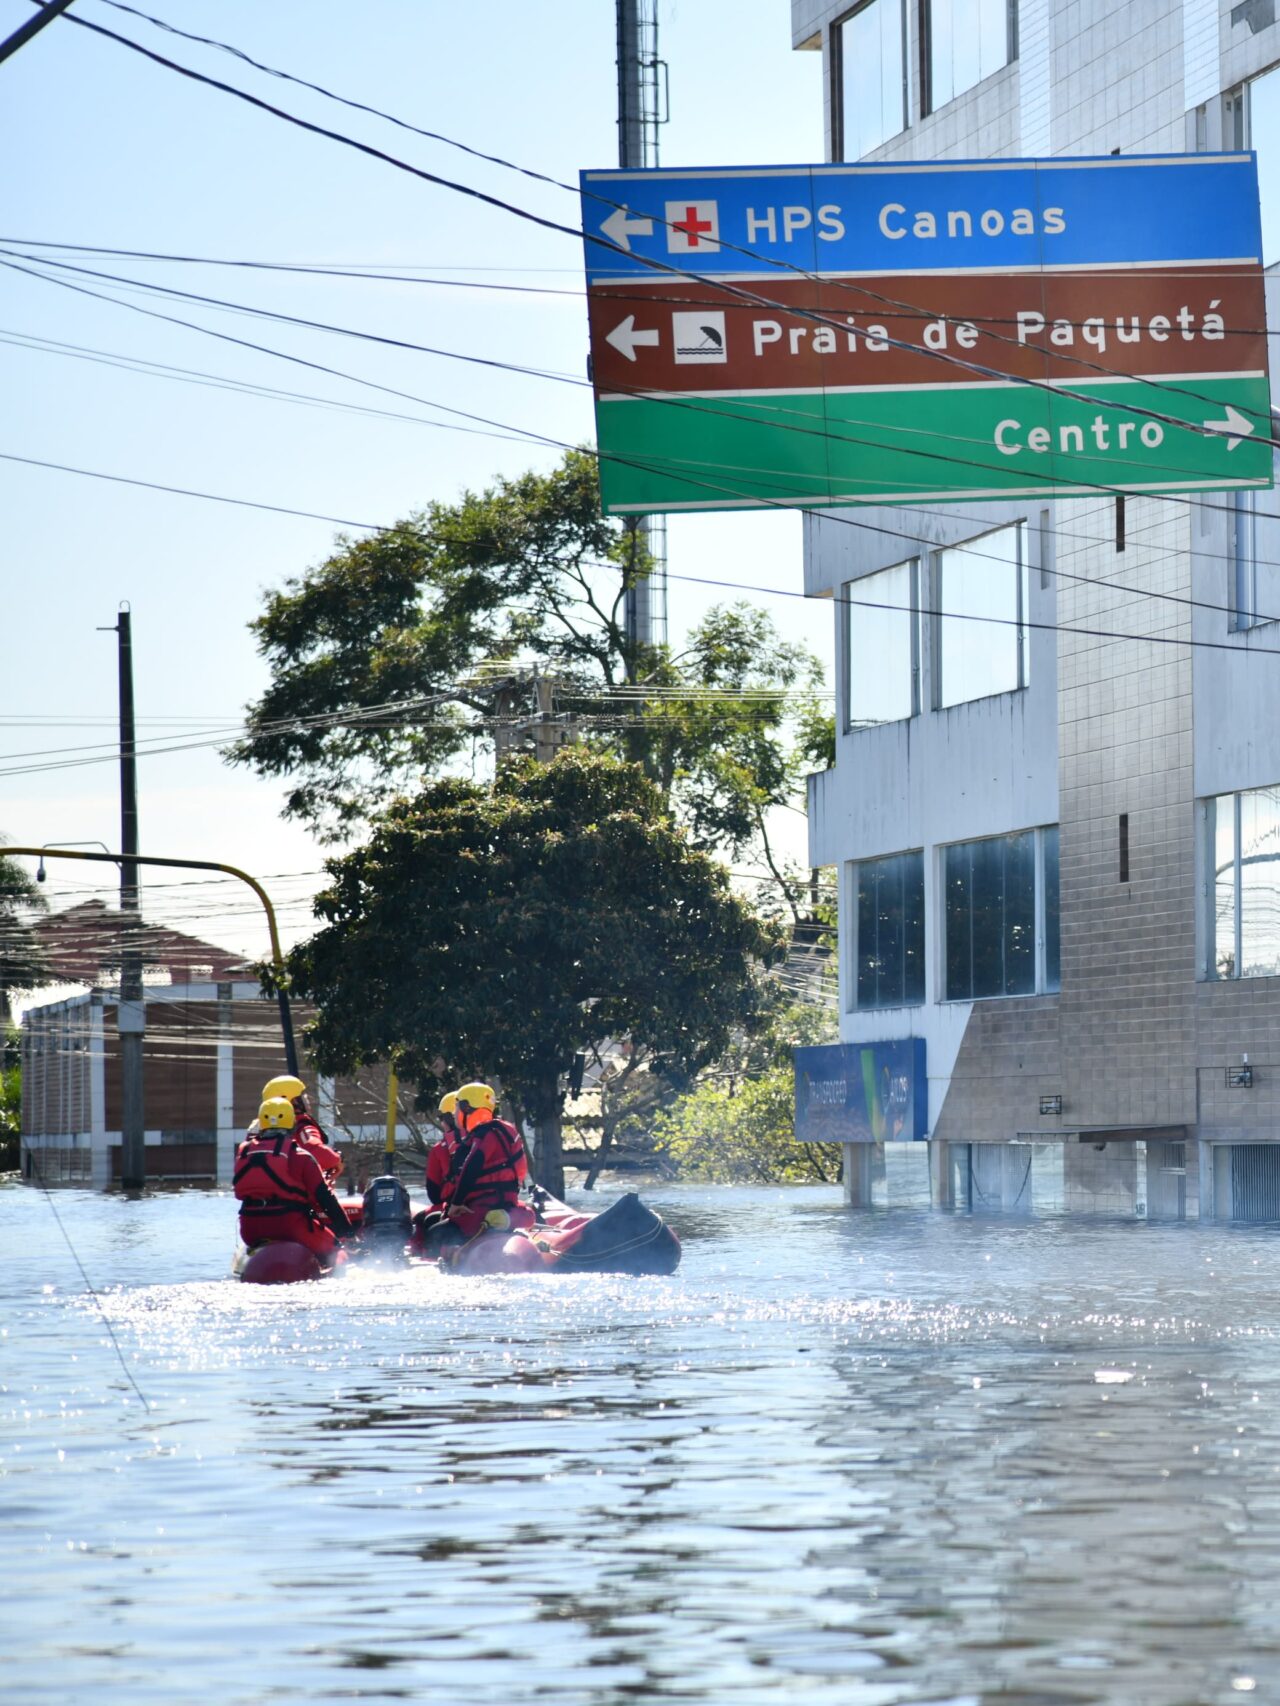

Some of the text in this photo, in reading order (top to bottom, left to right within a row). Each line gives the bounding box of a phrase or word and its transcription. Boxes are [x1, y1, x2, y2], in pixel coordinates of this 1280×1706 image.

[747, 202, 1068, 244] HPS Canoas
[752, 299, 1227, 357] Praia de Paquetá
[993, 416, 1165, 456] Centro
